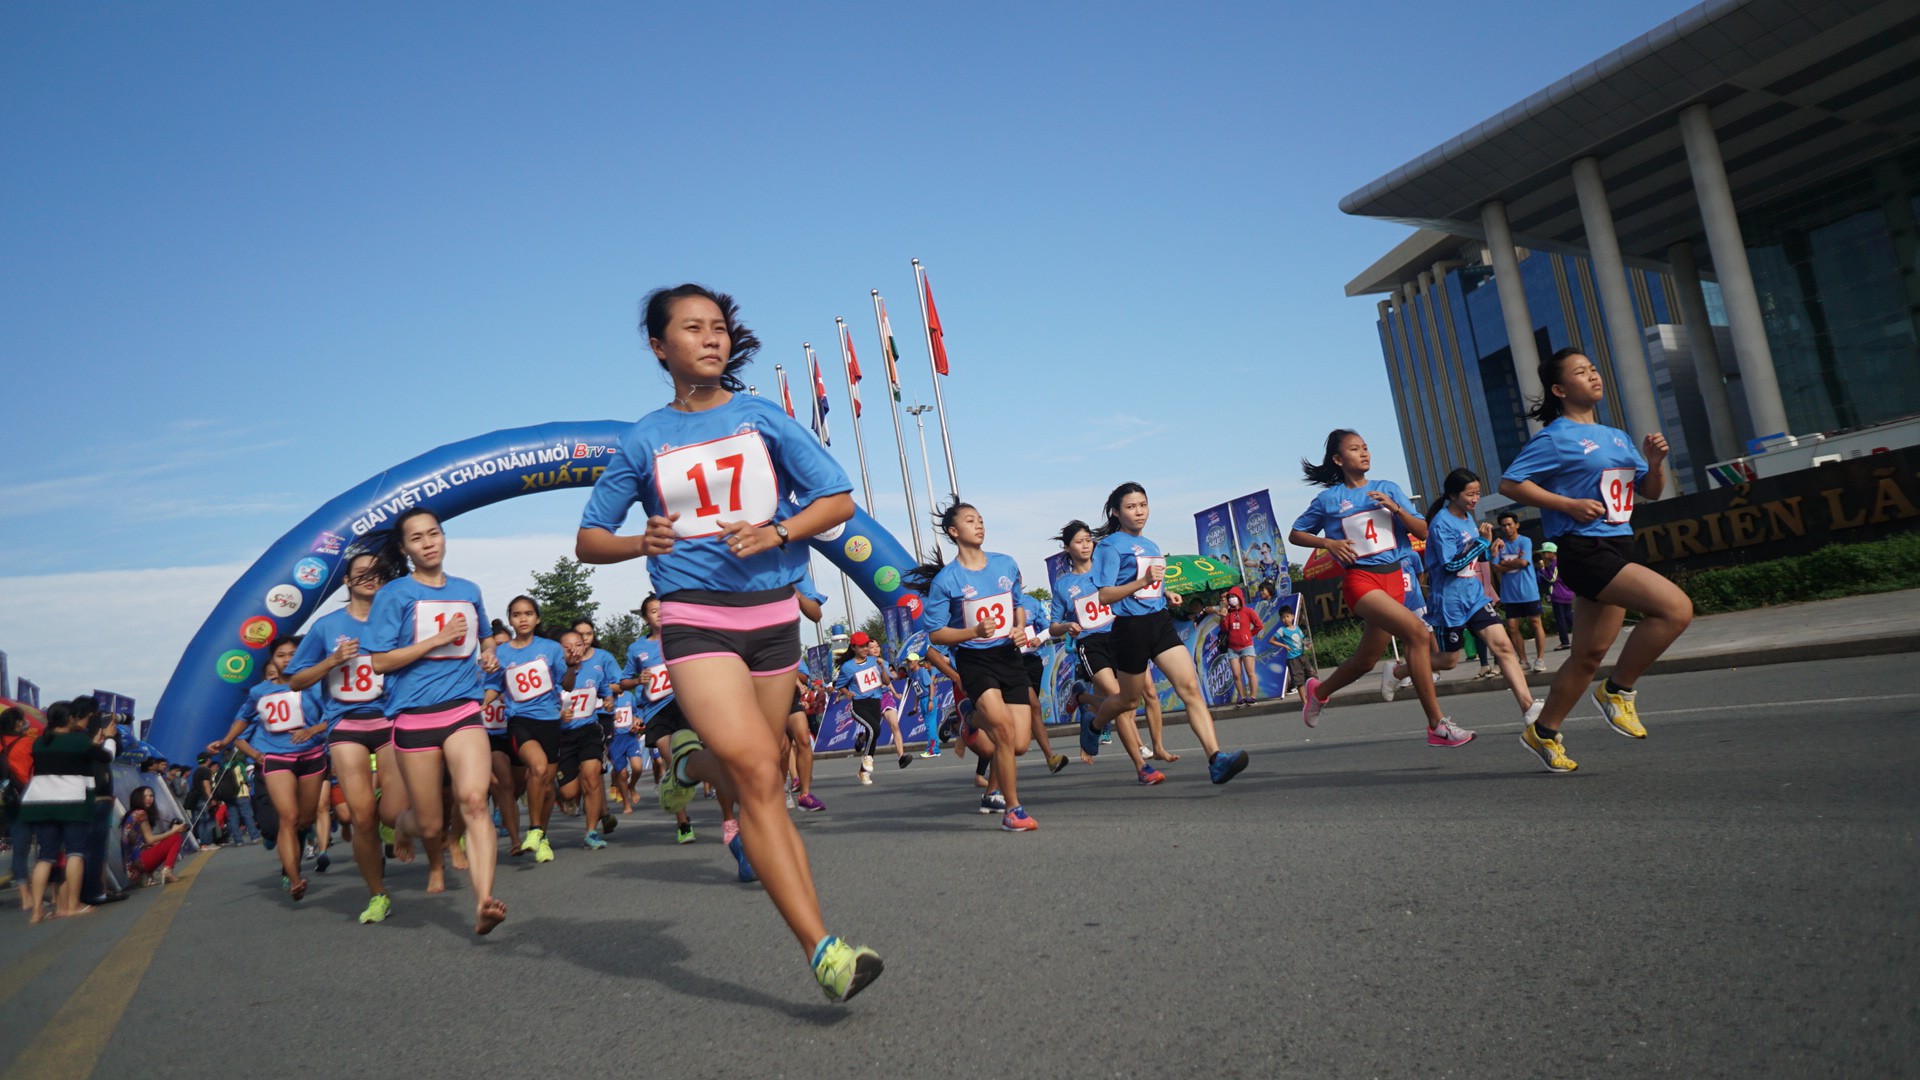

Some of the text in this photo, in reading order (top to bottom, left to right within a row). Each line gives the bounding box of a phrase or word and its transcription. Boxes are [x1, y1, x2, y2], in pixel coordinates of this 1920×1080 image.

[383, 487, 422, 514] VIỆT
[423, 475, 451, 498] DÃ
[450, 461, 497, 486] CHÀO
[497, 452, 536, 472] NĂM
[537, 443, 570, 464] MỚI
[572, 443, 605, 459] BTV
[521, 461, 588, 491] XUẤT
[687, 454, 744, 517] 17
[1634, 467, 1920, 562] TRIỂN LÃ
[1365, 519, 1377, 544] 4
[1085, 601, 1110, 621] 94
[340, 664, 373, 692] 18
[515, 668, 542, 693] 86
[650, 672, 672, 694] 22
[863, 671, 877, 686] 44
[265, 700, 291, 724] 20
[485, 704, 505, 723] 90
[570, 694, 589, 712] 77
